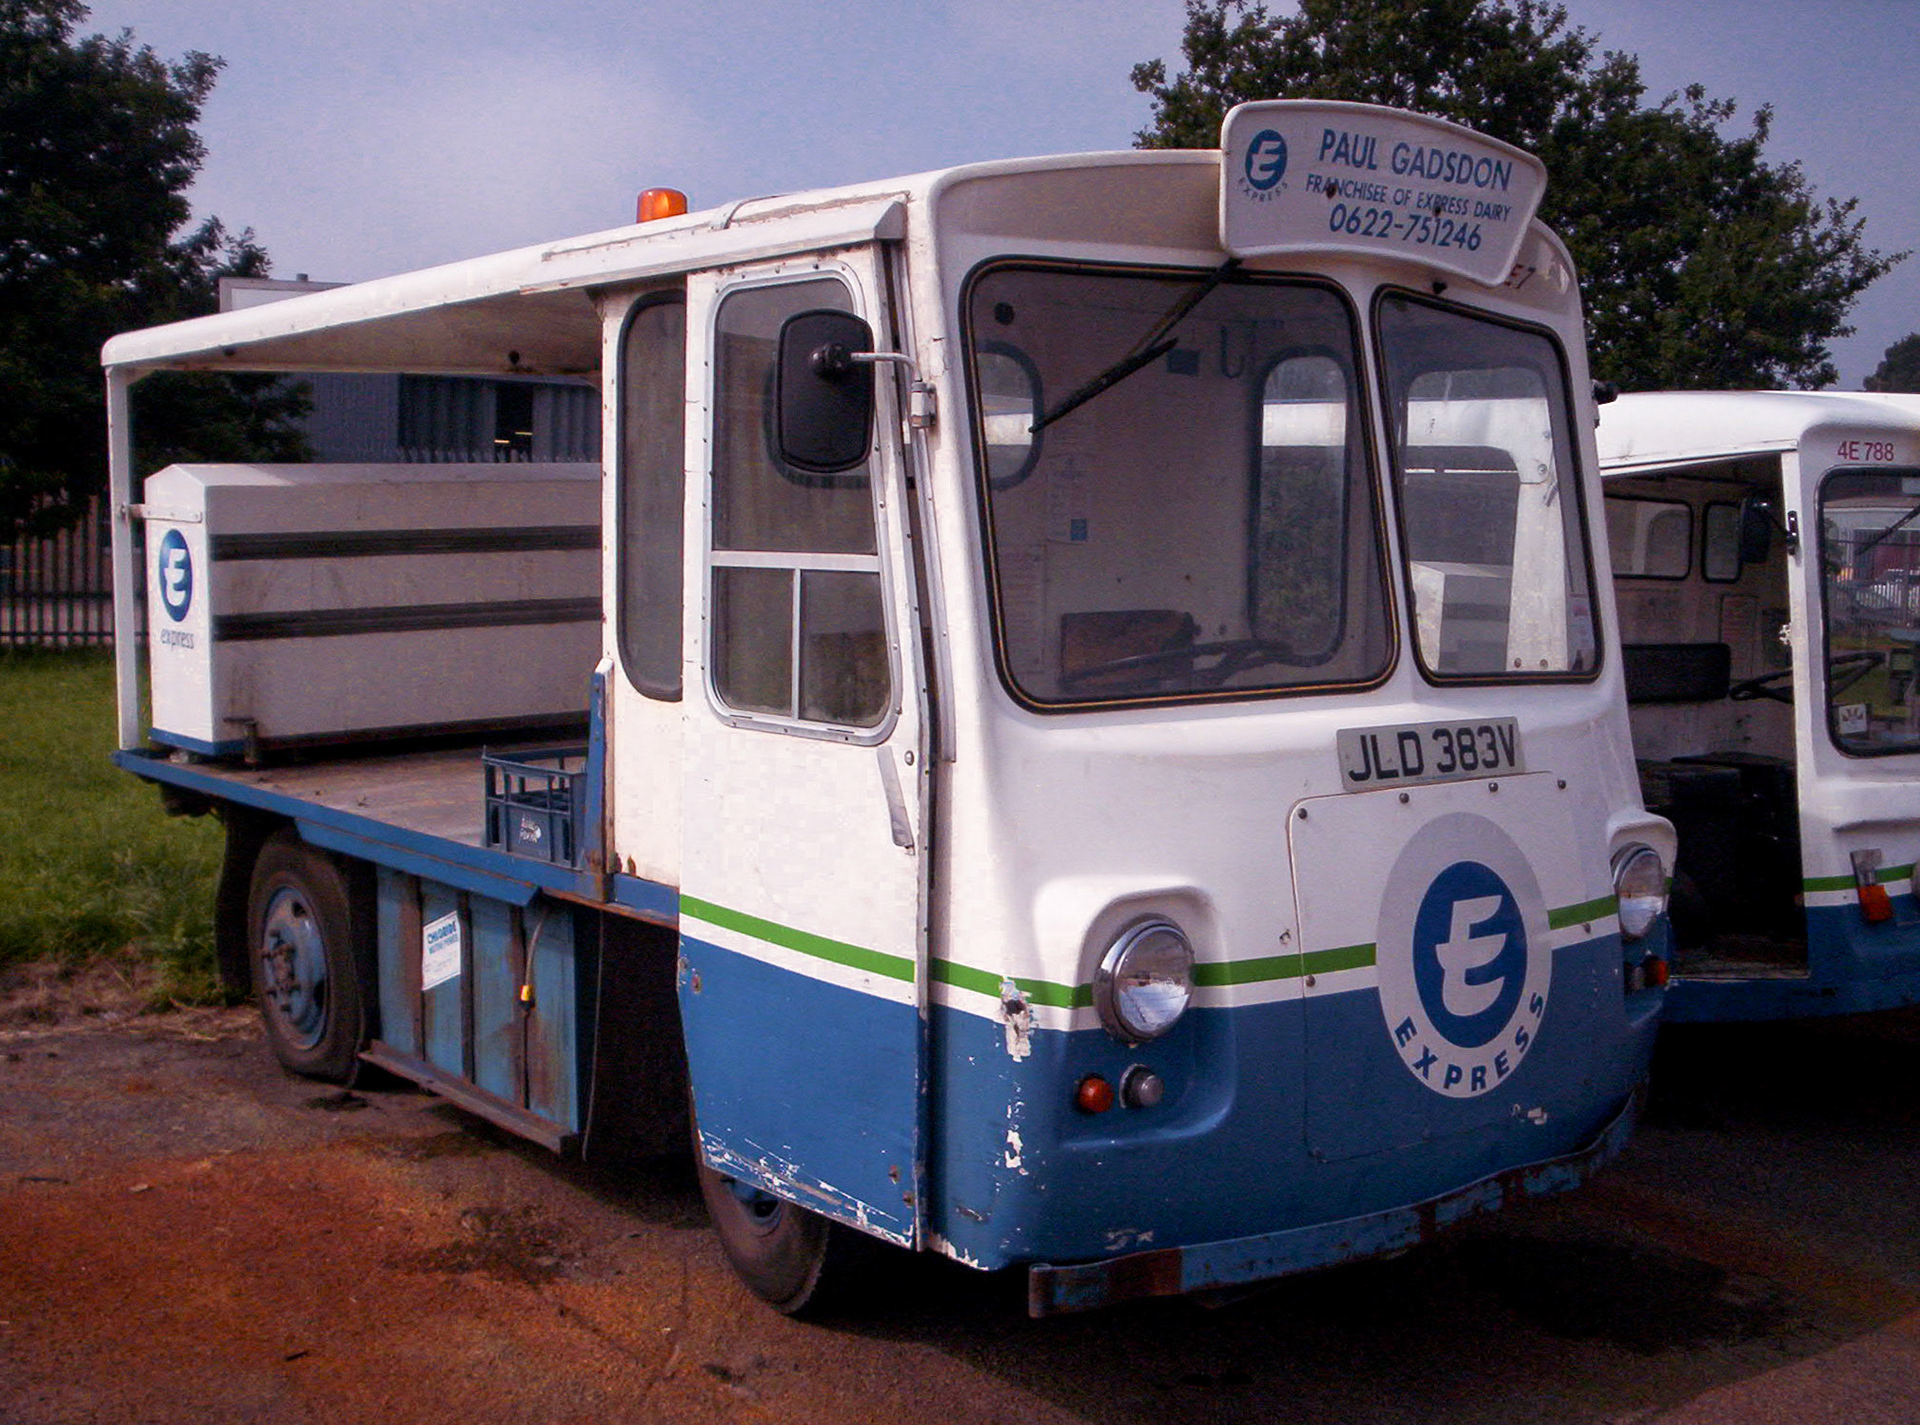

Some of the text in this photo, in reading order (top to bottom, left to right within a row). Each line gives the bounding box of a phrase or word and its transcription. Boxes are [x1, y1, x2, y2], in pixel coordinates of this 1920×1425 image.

[1319, 128, 1513, 191] PAUL GADSDON
[1238, 176, 1288, 202] EXPRESS
[1305, 173, 1512, 222] FRANCHISEE OF EXPRESS DAIRY
[1329, 203, 1482, 251] 0622-751246
[1837, 441, 1895, 462] 4E 788
[161, 629, 195, 652] express
[1348, 723, 1516, 782] JLD 383V
[1394, 991, 1544, 1092] EXPRESS
